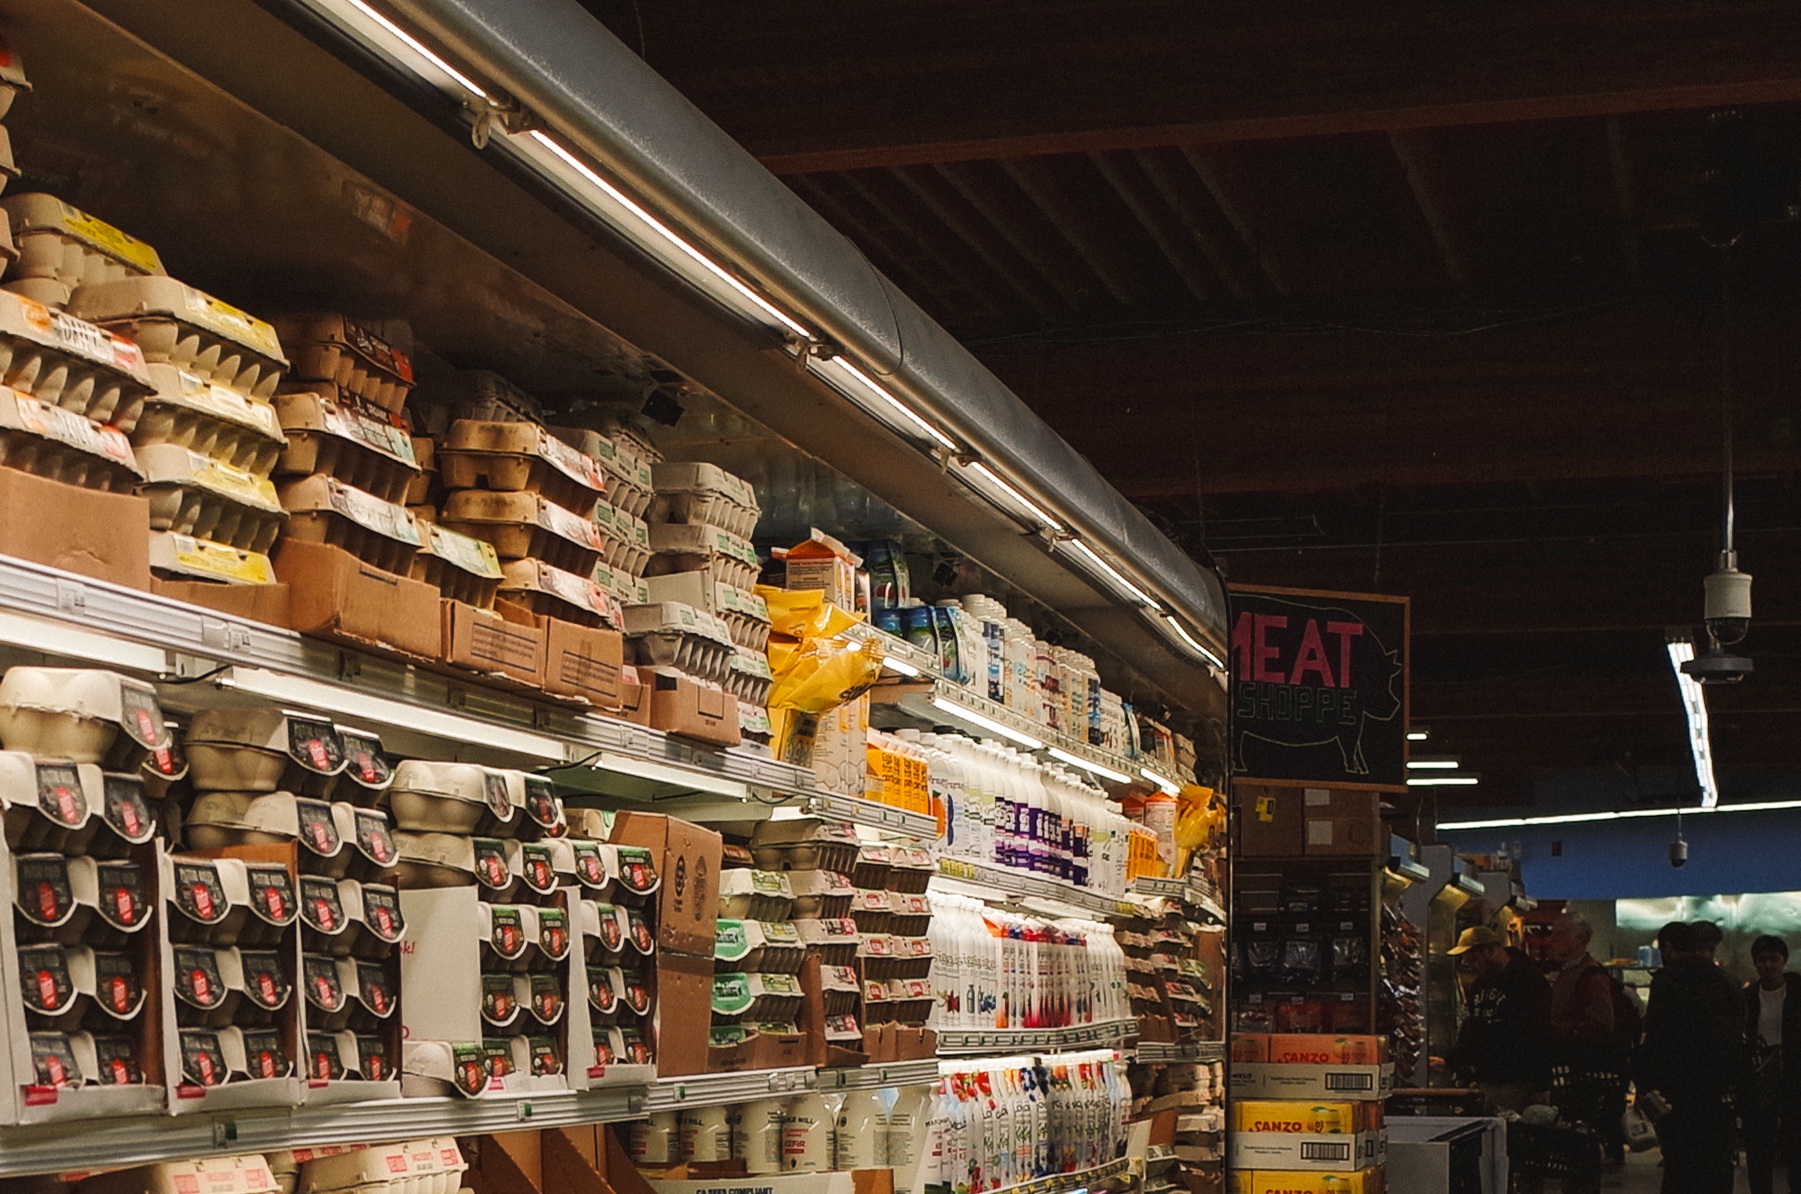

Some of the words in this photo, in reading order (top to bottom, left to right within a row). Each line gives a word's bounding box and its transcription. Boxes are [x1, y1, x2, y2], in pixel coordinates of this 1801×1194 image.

[1237, 681, 1357, 725] SHOPPE
[1282, 1052, 1330, 1063] SANZO
[1254, 1120, 1303, 1133] SANZO
